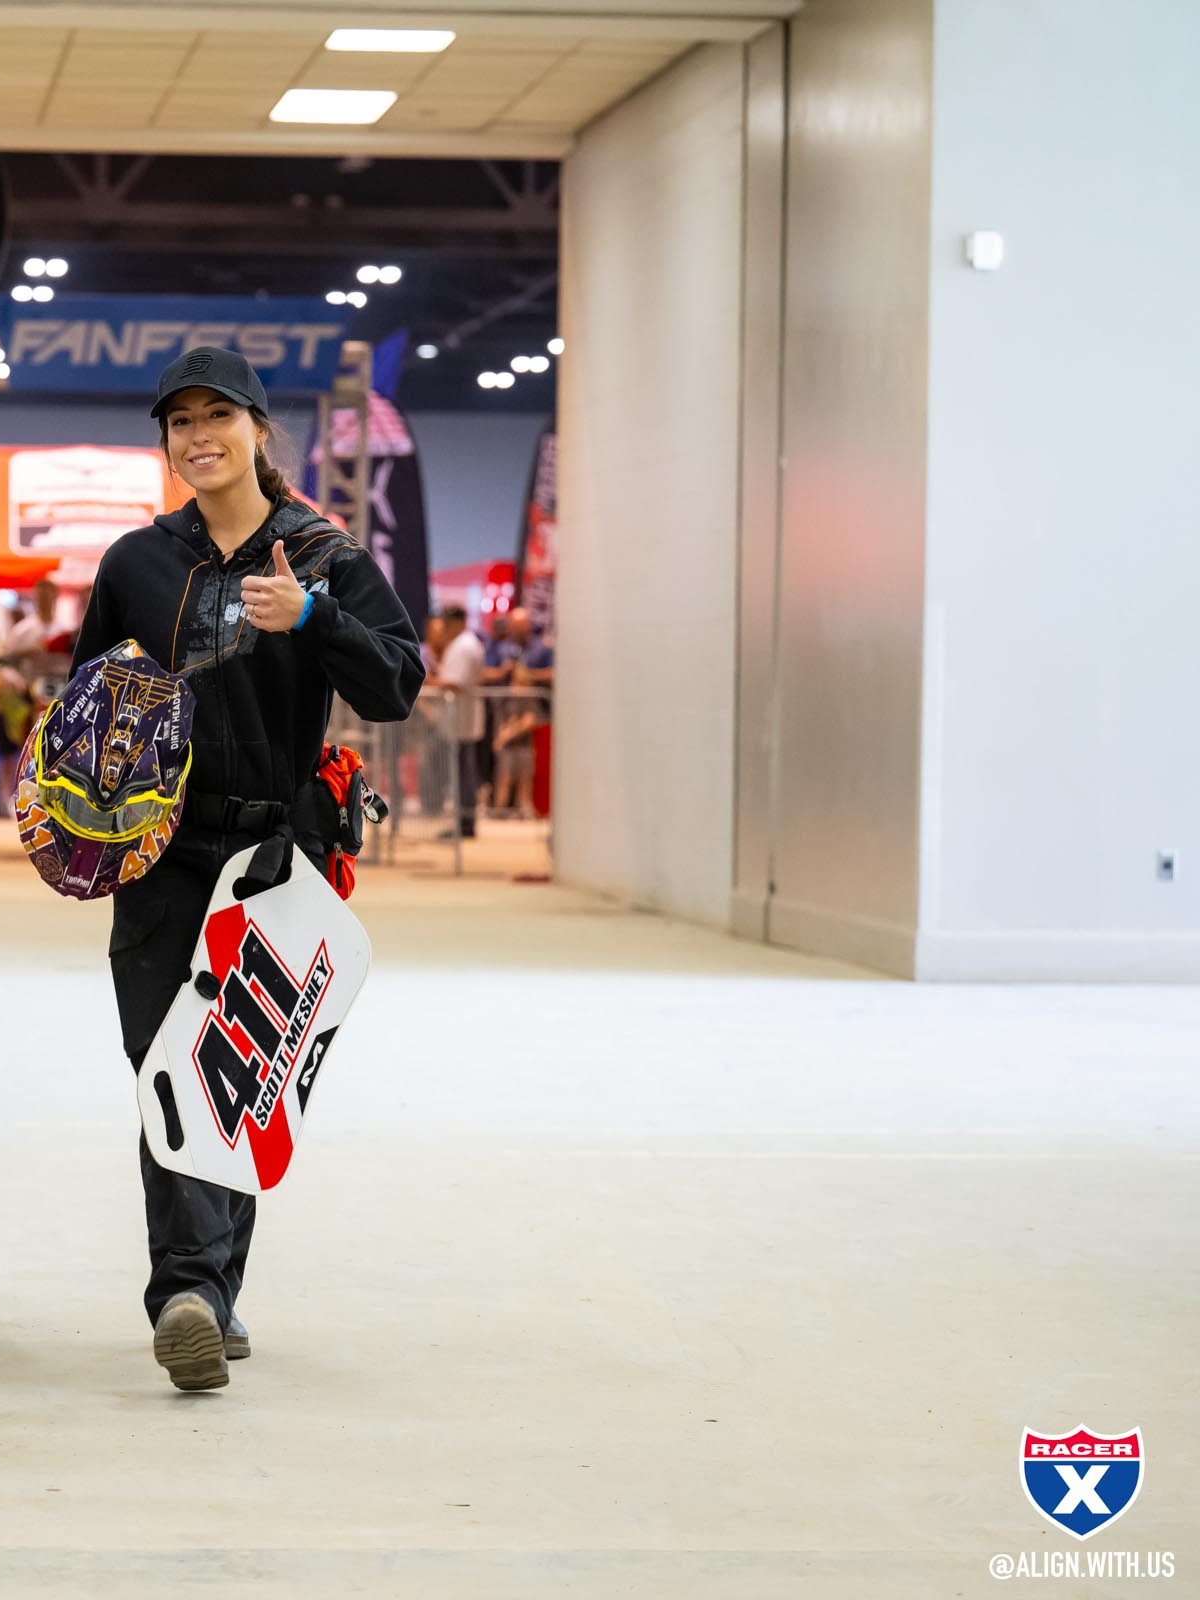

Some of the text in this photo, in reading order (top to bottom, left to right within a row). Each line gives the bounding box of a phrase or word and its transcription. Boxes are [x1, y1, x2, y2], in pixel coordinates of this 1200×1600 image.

[66, 694, 91, 724] HEADS
[87, 669, 104, 696] DIRTY
[170, 692, 182, 751] DIRTY HEADS
[196, 927, 302, 1141] 411
[254, 954, 331, 1128] SCOTT MESHEY
